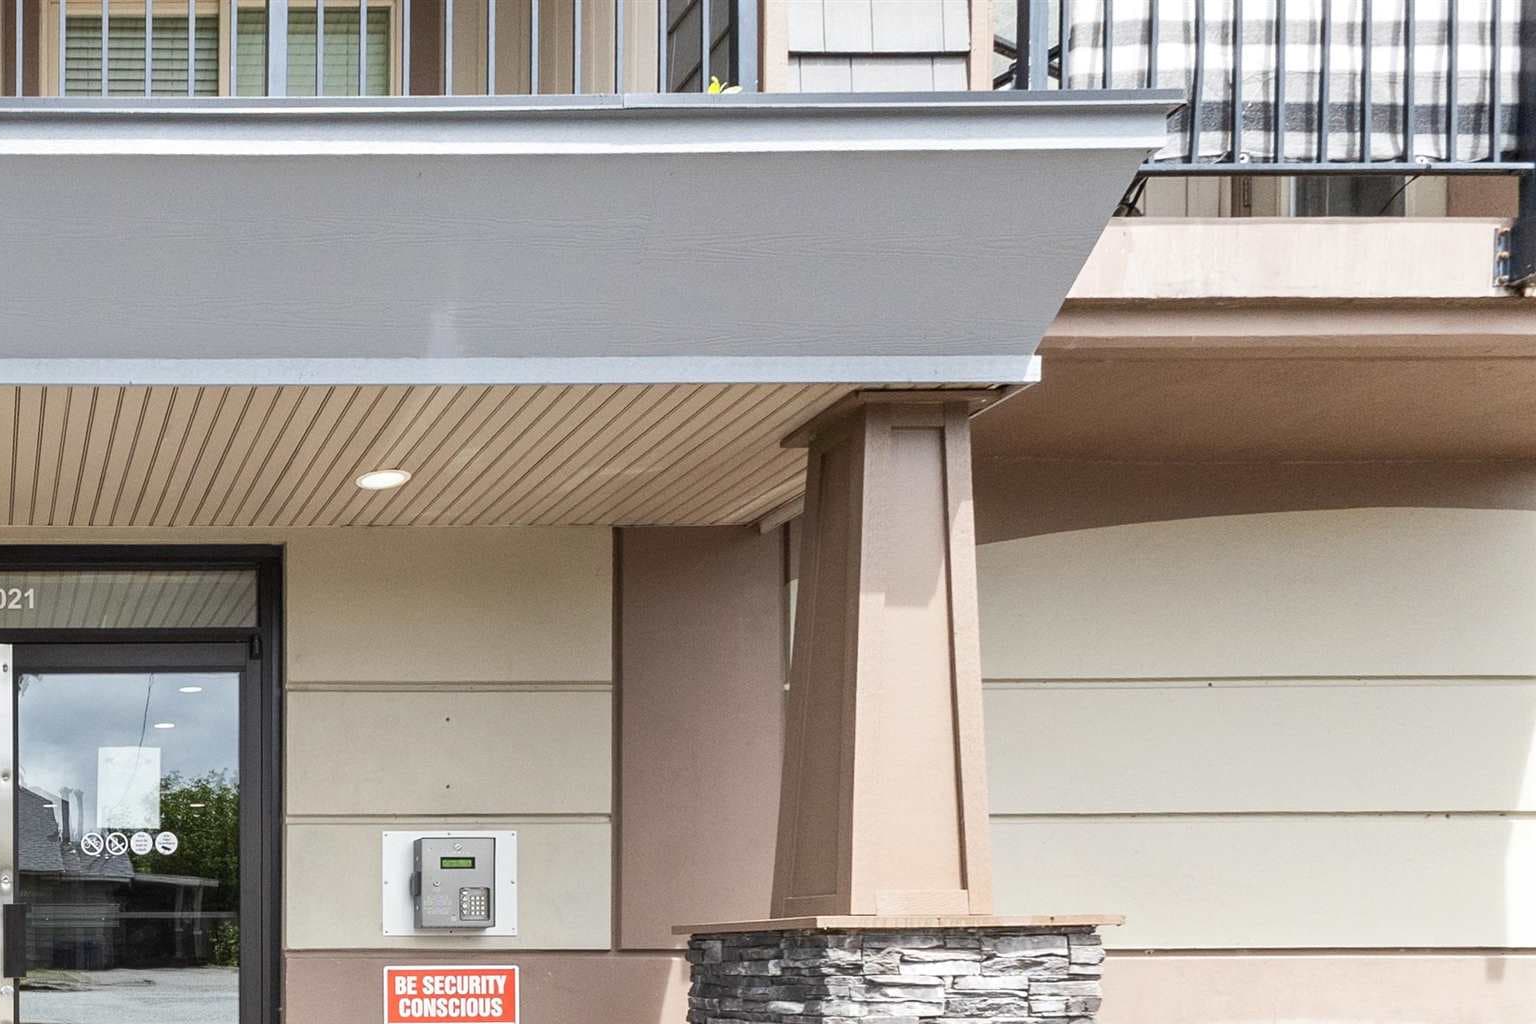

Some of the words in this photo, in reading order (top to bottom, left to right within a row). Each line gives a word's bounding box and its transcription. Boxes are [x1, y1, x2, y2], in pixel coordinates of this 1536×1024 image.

[394, 975, 418, 995] BE
[421, 975, 507, 995] SECURITY
[399, 997, 503, 1018] CONSCIOUS
